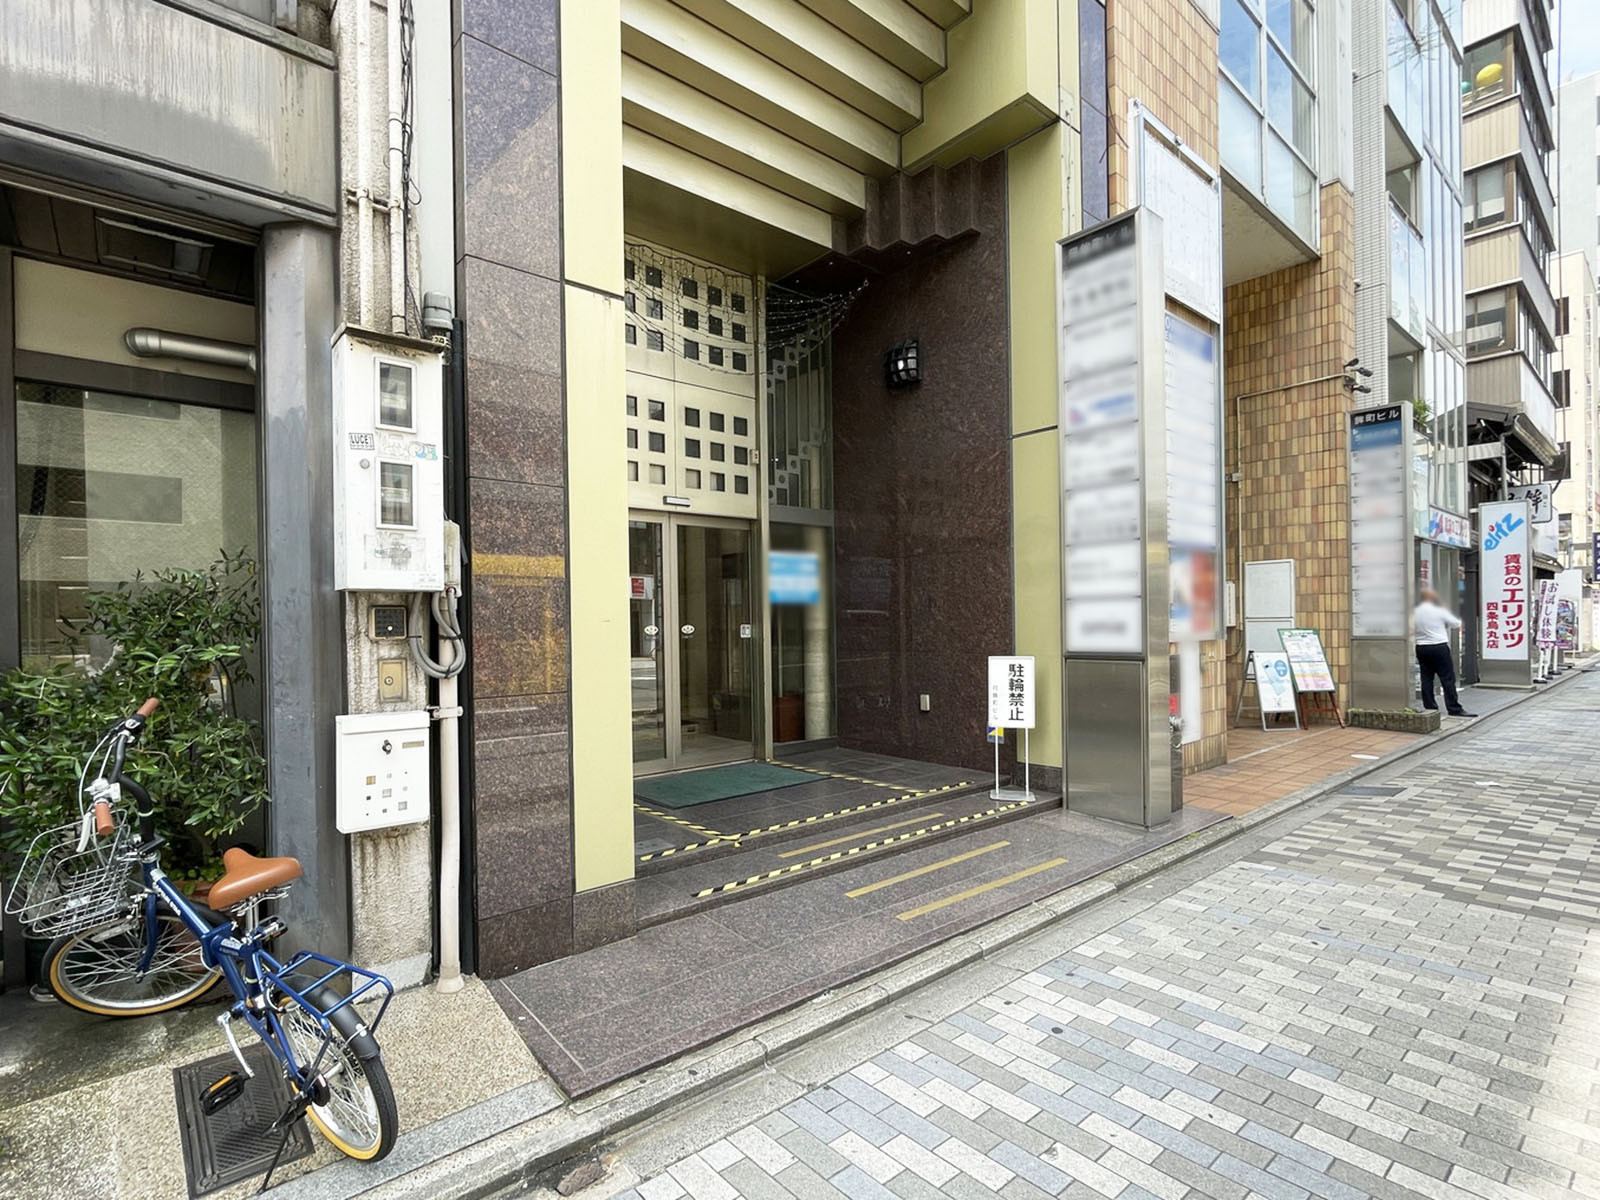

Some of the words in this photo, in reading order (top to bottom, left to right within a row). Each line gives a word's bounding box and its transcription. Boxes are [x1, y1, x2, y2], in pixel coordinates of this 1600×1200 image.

[1501, 553, 1525, 648] 賃貸のエリッツ
[1008, 663, 1025, 721] 駐輪禁止
